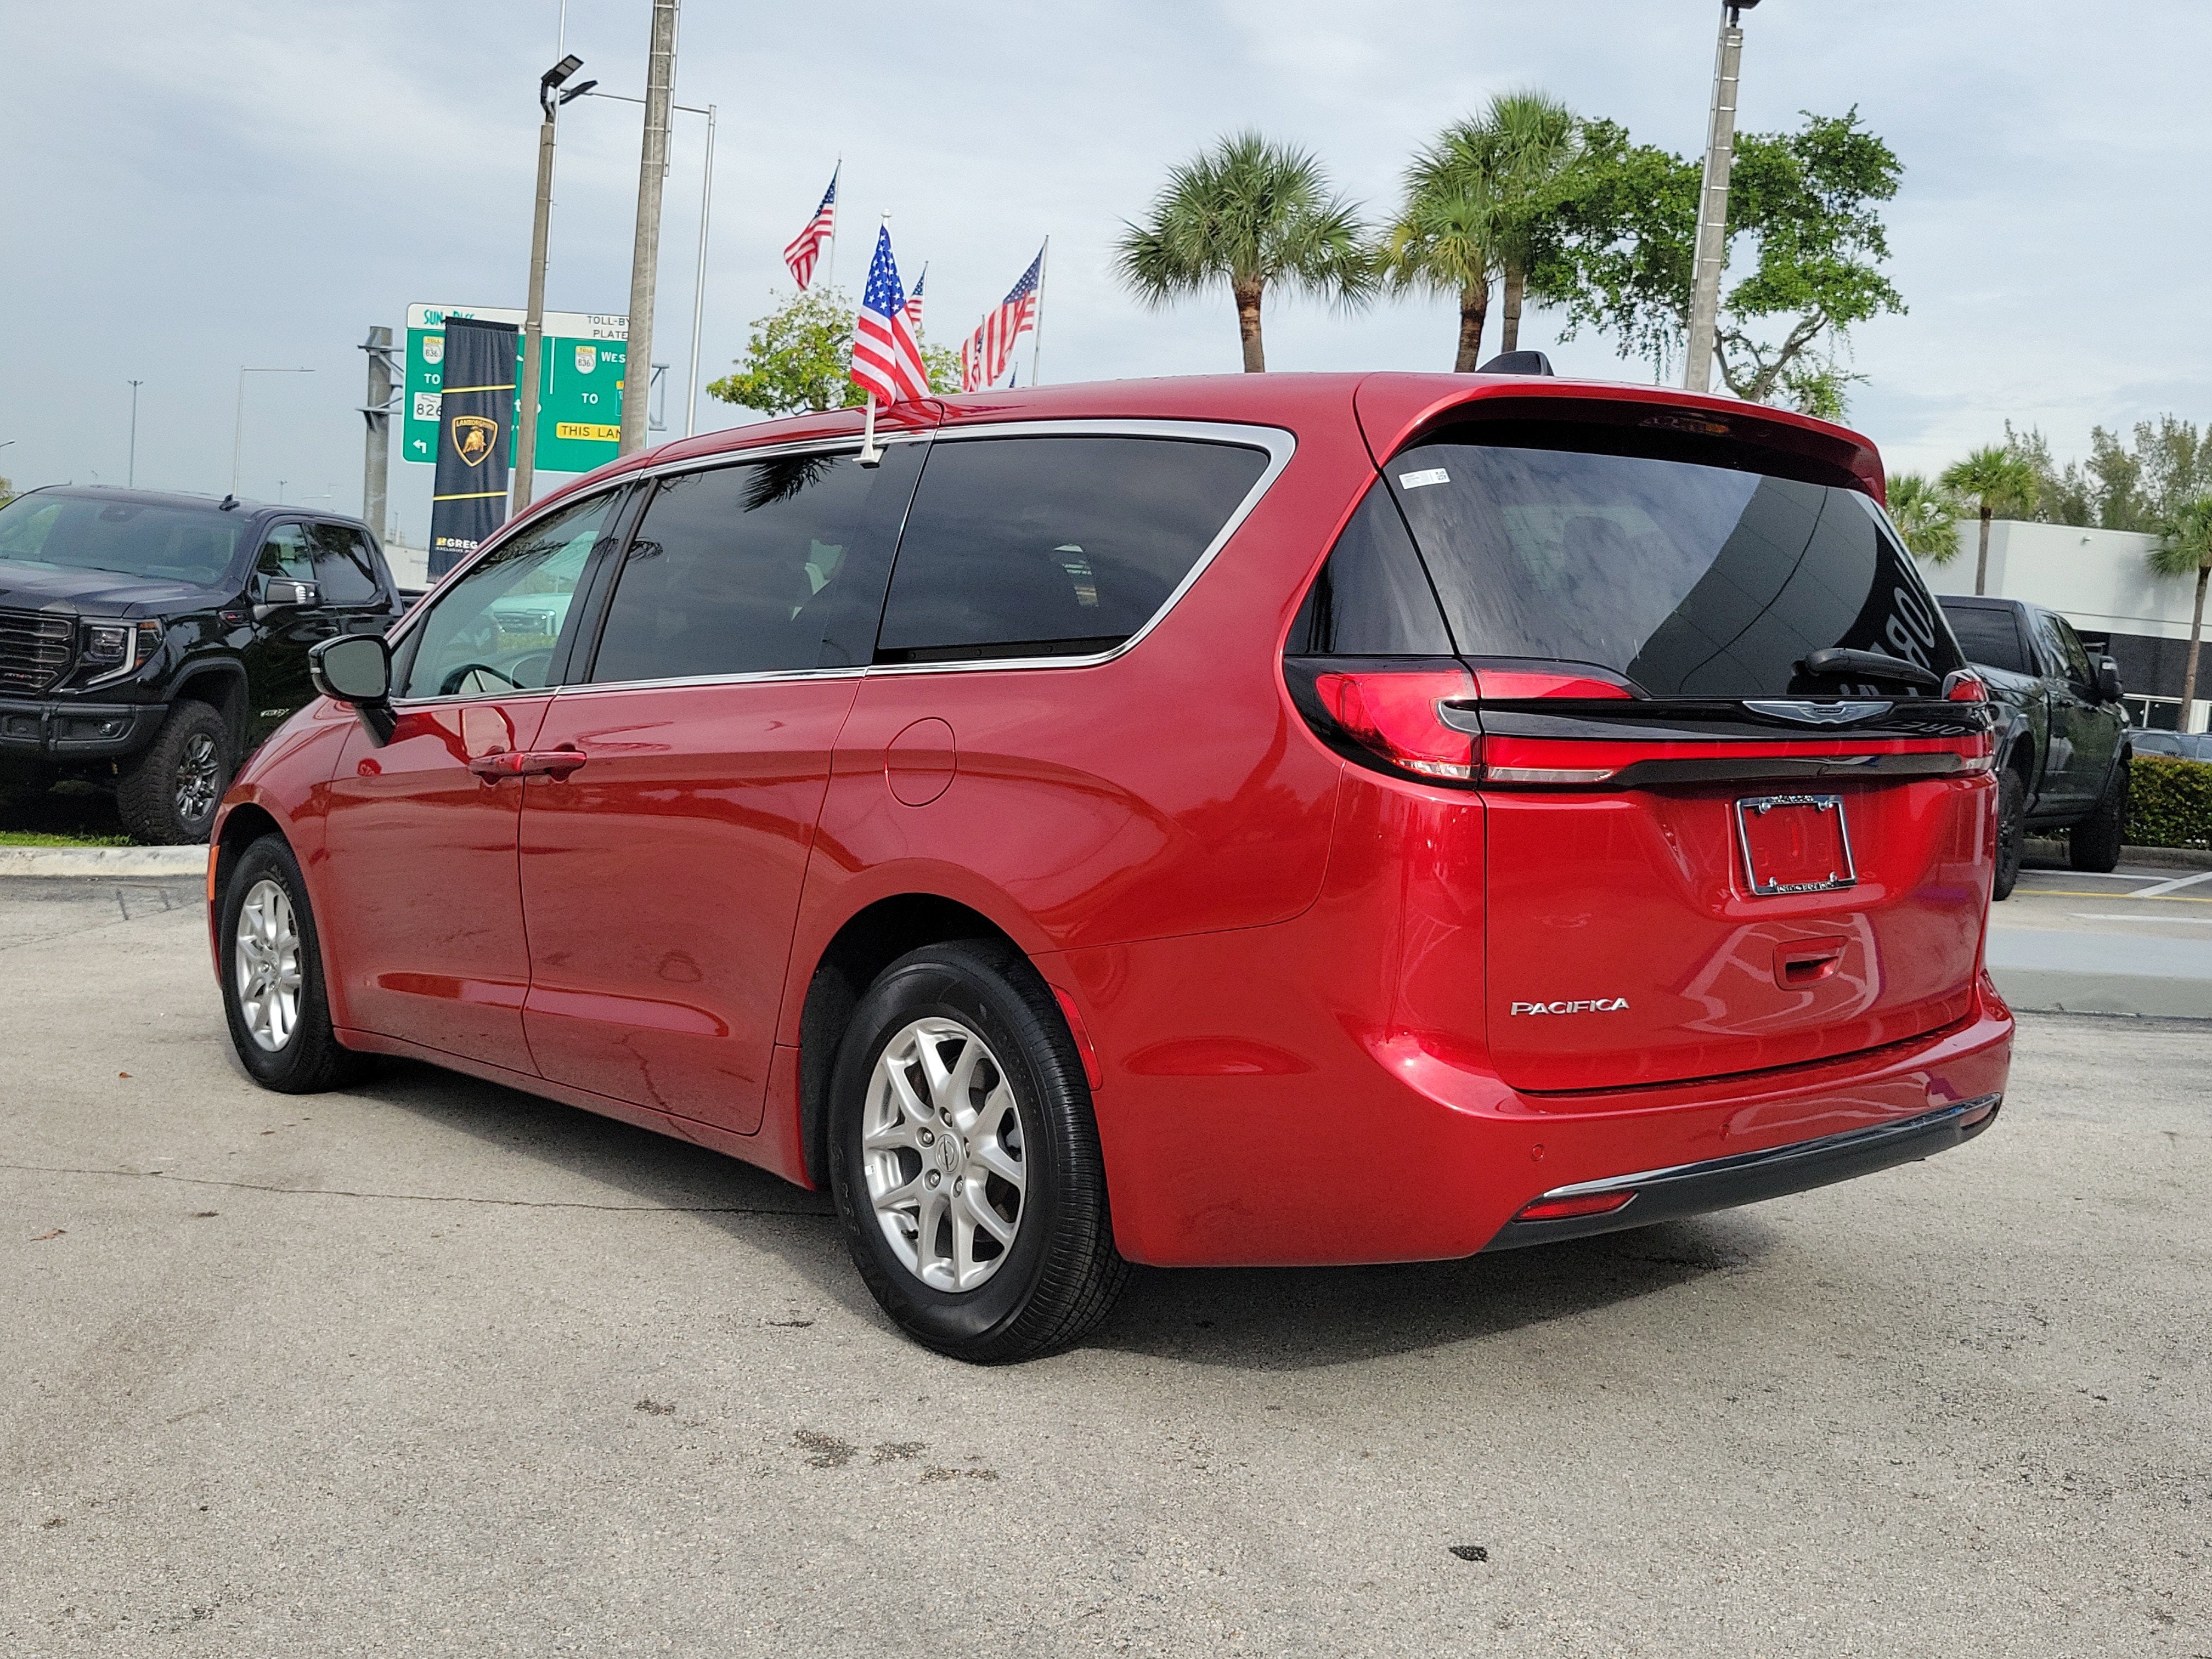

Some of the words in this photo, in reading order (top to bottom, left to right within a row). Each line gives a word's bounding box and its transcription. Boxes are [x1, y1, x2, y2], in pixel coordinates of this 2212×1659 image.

[594, 330, 629, 340] PLATE
[424, 374, 441, 385] TO
[582, 393, 599, 404] TO
[562, 426, 590, 437] THIS
[1510, 997, 1630, 1016] PACIFICA
